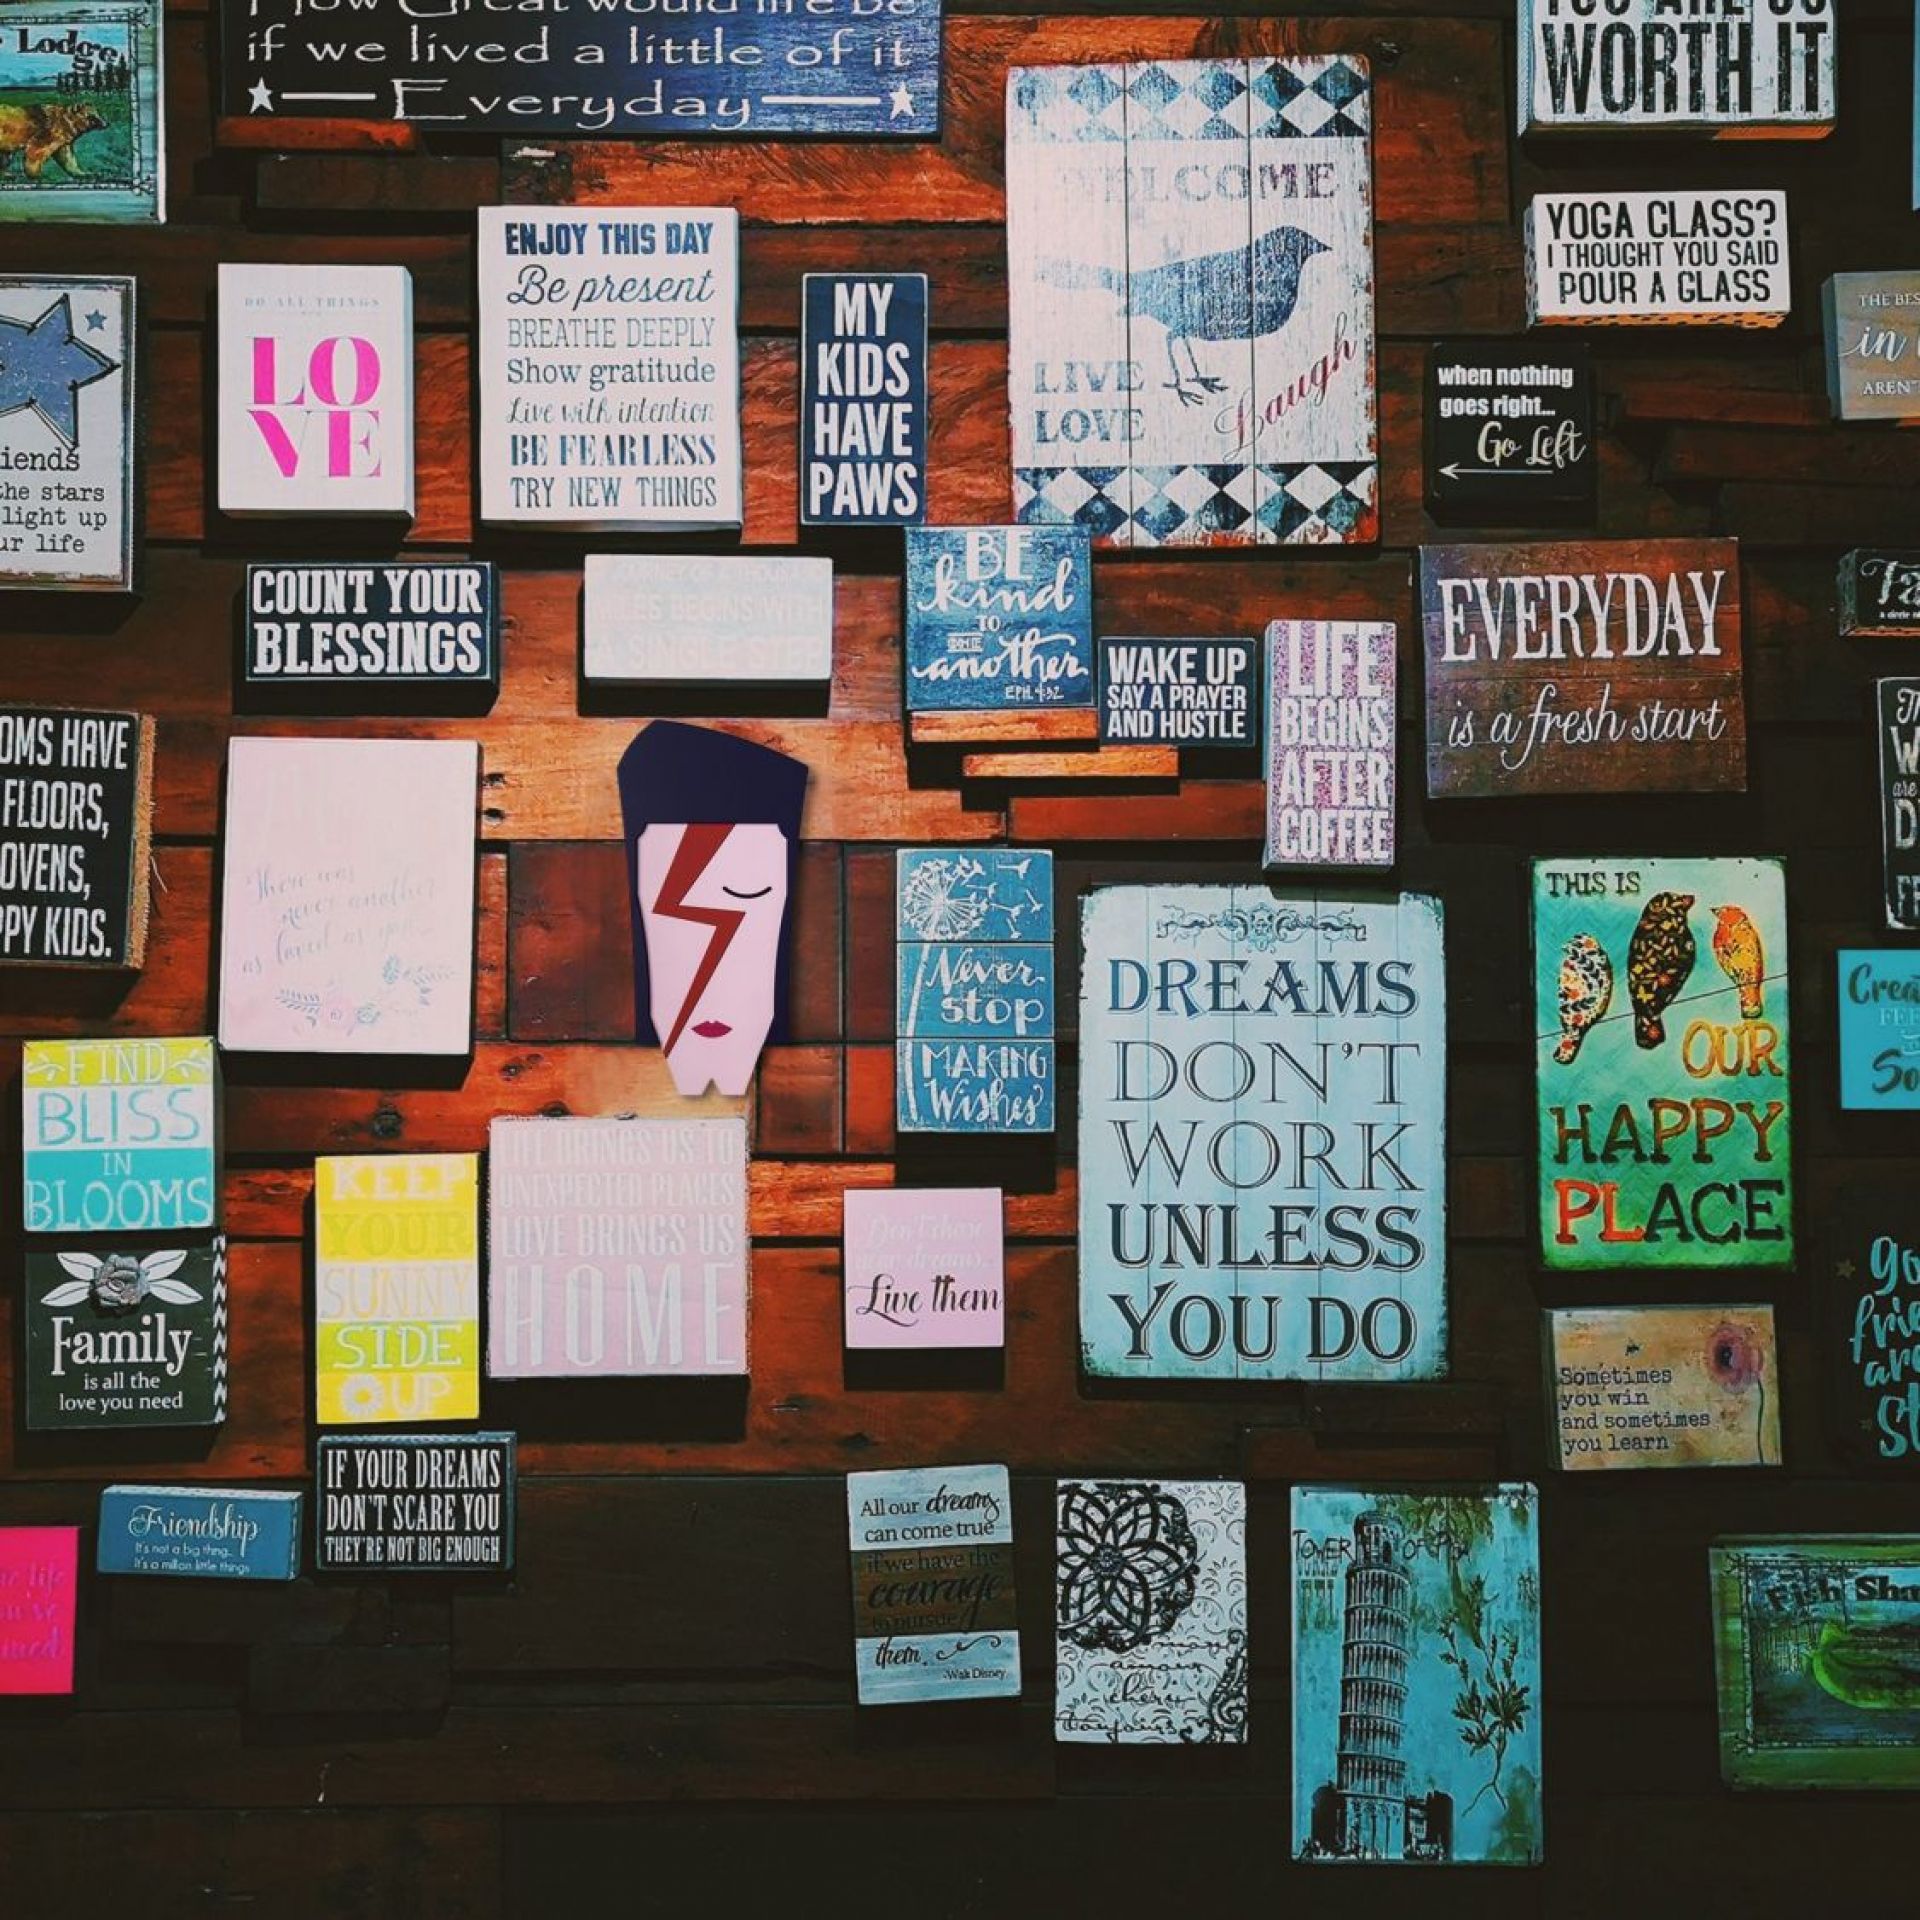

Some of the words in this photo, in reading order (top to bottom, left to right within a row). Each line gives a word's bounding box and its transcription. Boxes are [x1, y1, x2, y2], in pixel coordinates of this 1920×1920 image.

[17, 28, 118, 71] Lodge
[248, 24, 286, 62] if
[306, 43, 386, 63] we
[411, 25, 550, 63] lived
[574, 44, 605, 64] a
[630, 26, 763, 65] little
[786, 28, 855, 66] of
[874, 34, 913, 67] it
[1542, 22, 1752, 115] WORTH
[1777, 22, 1828, 113] IT
[390, 78, 752, 130] Everyday
[504, 222, 588, 255] ENJOY
[598, 222, 656, 255] THIS
[665, 222, 713, 255] DAY
[1546, 202, 1634, 240] YOGA
[1647, 199, 1776, 238] CLASS?
[1547, 247, 1554, 267] I
[1562, 243, 1664, 267] THOUGHT
[1673, 242, 1717, 267] YOU
[1728, 240, 1778, 266] SAID
[507, 264, 569, 305] Be
[572, 269, 716, 311] present
[834, 282, 894, 336] MY
[1559, 274, 1637, 304] POUR
[1650, 272, 1665, 302] A
[1678, 271, 1771, 302] GLASS
[1858, 293, 1890, 308] THE
[507, 318, 616, 348] BREATHE
[627, 317, 716, 347] DEEPLY
[1838, 326, 1906, 362] in
[507, 357, 582, 384] Show
[589, 356, 716, 392] gratitude
[818, 342, 910, 397] KIDS
[1034, 361, 1145, 394] LIVE
[1214, 312, 1357, 463] Laugh
[1437, 364, 1493, 386] when
[1496, 364, 1574, 389] nothing
[507, 396, 553, 424] Live
[561, 397, 612, 424] with
[618, 397, 715, 424] intention
[814, 402, 913, 456] HAVE
[1035, 409, 1145, 443] LOVE
[1440, 396, 1490, 418] goes
[511, 434, 549, 466] BE
[560, 434, 716, 466] FEARLESS
[1477, 421, 1521, 467] Go
[1525, 419, 1587, 469] Left
[41, 481, 105, 502] stars
[509, 476, 555, 508] TRY
[569, 476, 621, 508] NEW
[635, 476, 717, 507] THINGS
[809, 461, 919, 516] PAWS
[2, 506, 67, 530] light
[80, 511, 107, 531] up
[36, 533, 85, 553] life
[965, 529, 1033, 581] BE
[253, 569, 374, 614] COUNT
[384, 569, 483, 614] YOUR
[917, 554, 1074, 612] kind
[976, 616, 1000, 632] TO
[1438, 571, 1725, 662] EVERYDAY
[253, 622, 482, 675] BLESSINGS
[911, 628, 1089, 682] another
[1108, 647, 1197, 684] WAKE
[1206, 648, 1247, 684] UP
[1289, 622, 1382, 697] LIFE
[1107, 685, 1144, 709] SAY
[1151, 685, 1163, 709] A
[1169, 685, 1247, 710] PRAYER
[1107, 711, 1153, 738] AND
[1160, 711, 1247, 738] HUSTLE
[1281, 699, 1389, 747] BEGINS
[1449, 700, 1475, 747] is
[1490, 712, 1521, 743] a
[1500, 683, 1627, 770] fresh
[1632, 699, 1726, 741] start
[61, 718, 129, 769] HAVE
[1281, 751, 1389, 807] AFTER
[3, 779, 109, 839] FLOORS,
[1280, 809, 1389, 860] COFFEE
[1546, 872, 1606, 897] THIS
[1615, 871, 1641, 893] IS
[44, 907, 112, 957] KIDS.
[926, 947, 1046, 995] Never
[1107, 958, 1420, 1018] DREAMS
[942, 987, 1044, 1036] stop
[69, 1043, 165, 1087] FIND
[922, 1044, 1045, 1079] MAKING
[1682, 1020, 1783, 1077] OUR
[1109, 1040, 1421, 1105] DON'T
[38, 1088, 199, 1146] BLISS
[923, 1078, 1043, 1127] Wishes
[1549, 1098, 1784, 1164] HAPPY
[103, 1152, 132, 1176] IN
[1107, 1120, 1425, 1191] WORK
[332, 1161, 466, 1200] KEEP
[26, 1177, 212, 1230] BLOOMS
[1554, 1179, 1786, 1244] PLACE
[503, 1214, 569, 1257] LOVE
[578, 1213, 686, 1257] BRINGS
[699, 1213, 737, 1257] US
[1106, 1203, 1425, 1272] UNLESS
[322, 1266, 472, 1319] SUNNY
[504, 1262, 738, 1367] HOME
[848, 1274, 923, 1327] Live
[931, 1275, 1000, 1313] them
[1107, 1280, 1282, 1363] YOU
[1307, 1297, 1417, 1363] DO
[50, 1313, 193, 1376] Family
[333, 1323, 464, 1370] SIDE
[84, 1373, 98, 1391] is
[102, 1372, 124, 1389] all
[130, 1371, 160, 1389] the
[391, 1375, 451, 1417] UP
[1560, 1366, 1672, 1386] Sometimes
[59, 1393, 96, 1411] love
[100, 1396, 134, 1415] you
[139, 1391, 183, 1410] need
[1560, 1392, 1600, 1411] you
[1608, 1389, 1649, 1406] win
[1562, 1413, 1598, 1430] and
[1604, 1411, 1710, 1429] sometimes
[1564, 1437, 1602, 1456] you
[1610, 1434, 1670, 1451] learn
[326, 1449, 348, 1489] IF
[354, 1449, 408, 1489] YOUR
[415, 1449, 500, 1489] DREAMS
[326, 1494, 388, 1531] DON'T
[393, 1494, 456, 1531] SCARE
[462, 1494, 500, 1531] YOU
[861, 1499, 885, 1517] All
[888, 1501, 919, 1515] our
[926, 1485, 1000, 1522] dreams
[128, 1503, 262, 1558] Friendship
[325, 1536, 384, 1563] THEY'RE
[387, 1536, 415, 1563] NOT
[419, 1536, 441, 1562] BIG
[445, 1536, 500, 1562] ENOUGH
[865, 1527, 897, 1543] can
[902, 1524, 952, 1541] come
[957, 1519, 995, 1537] true
[867, 1553, 884, 1572] if
[887, 1557, 913, 1571] we
[917, 1551, 964, 1570] have
